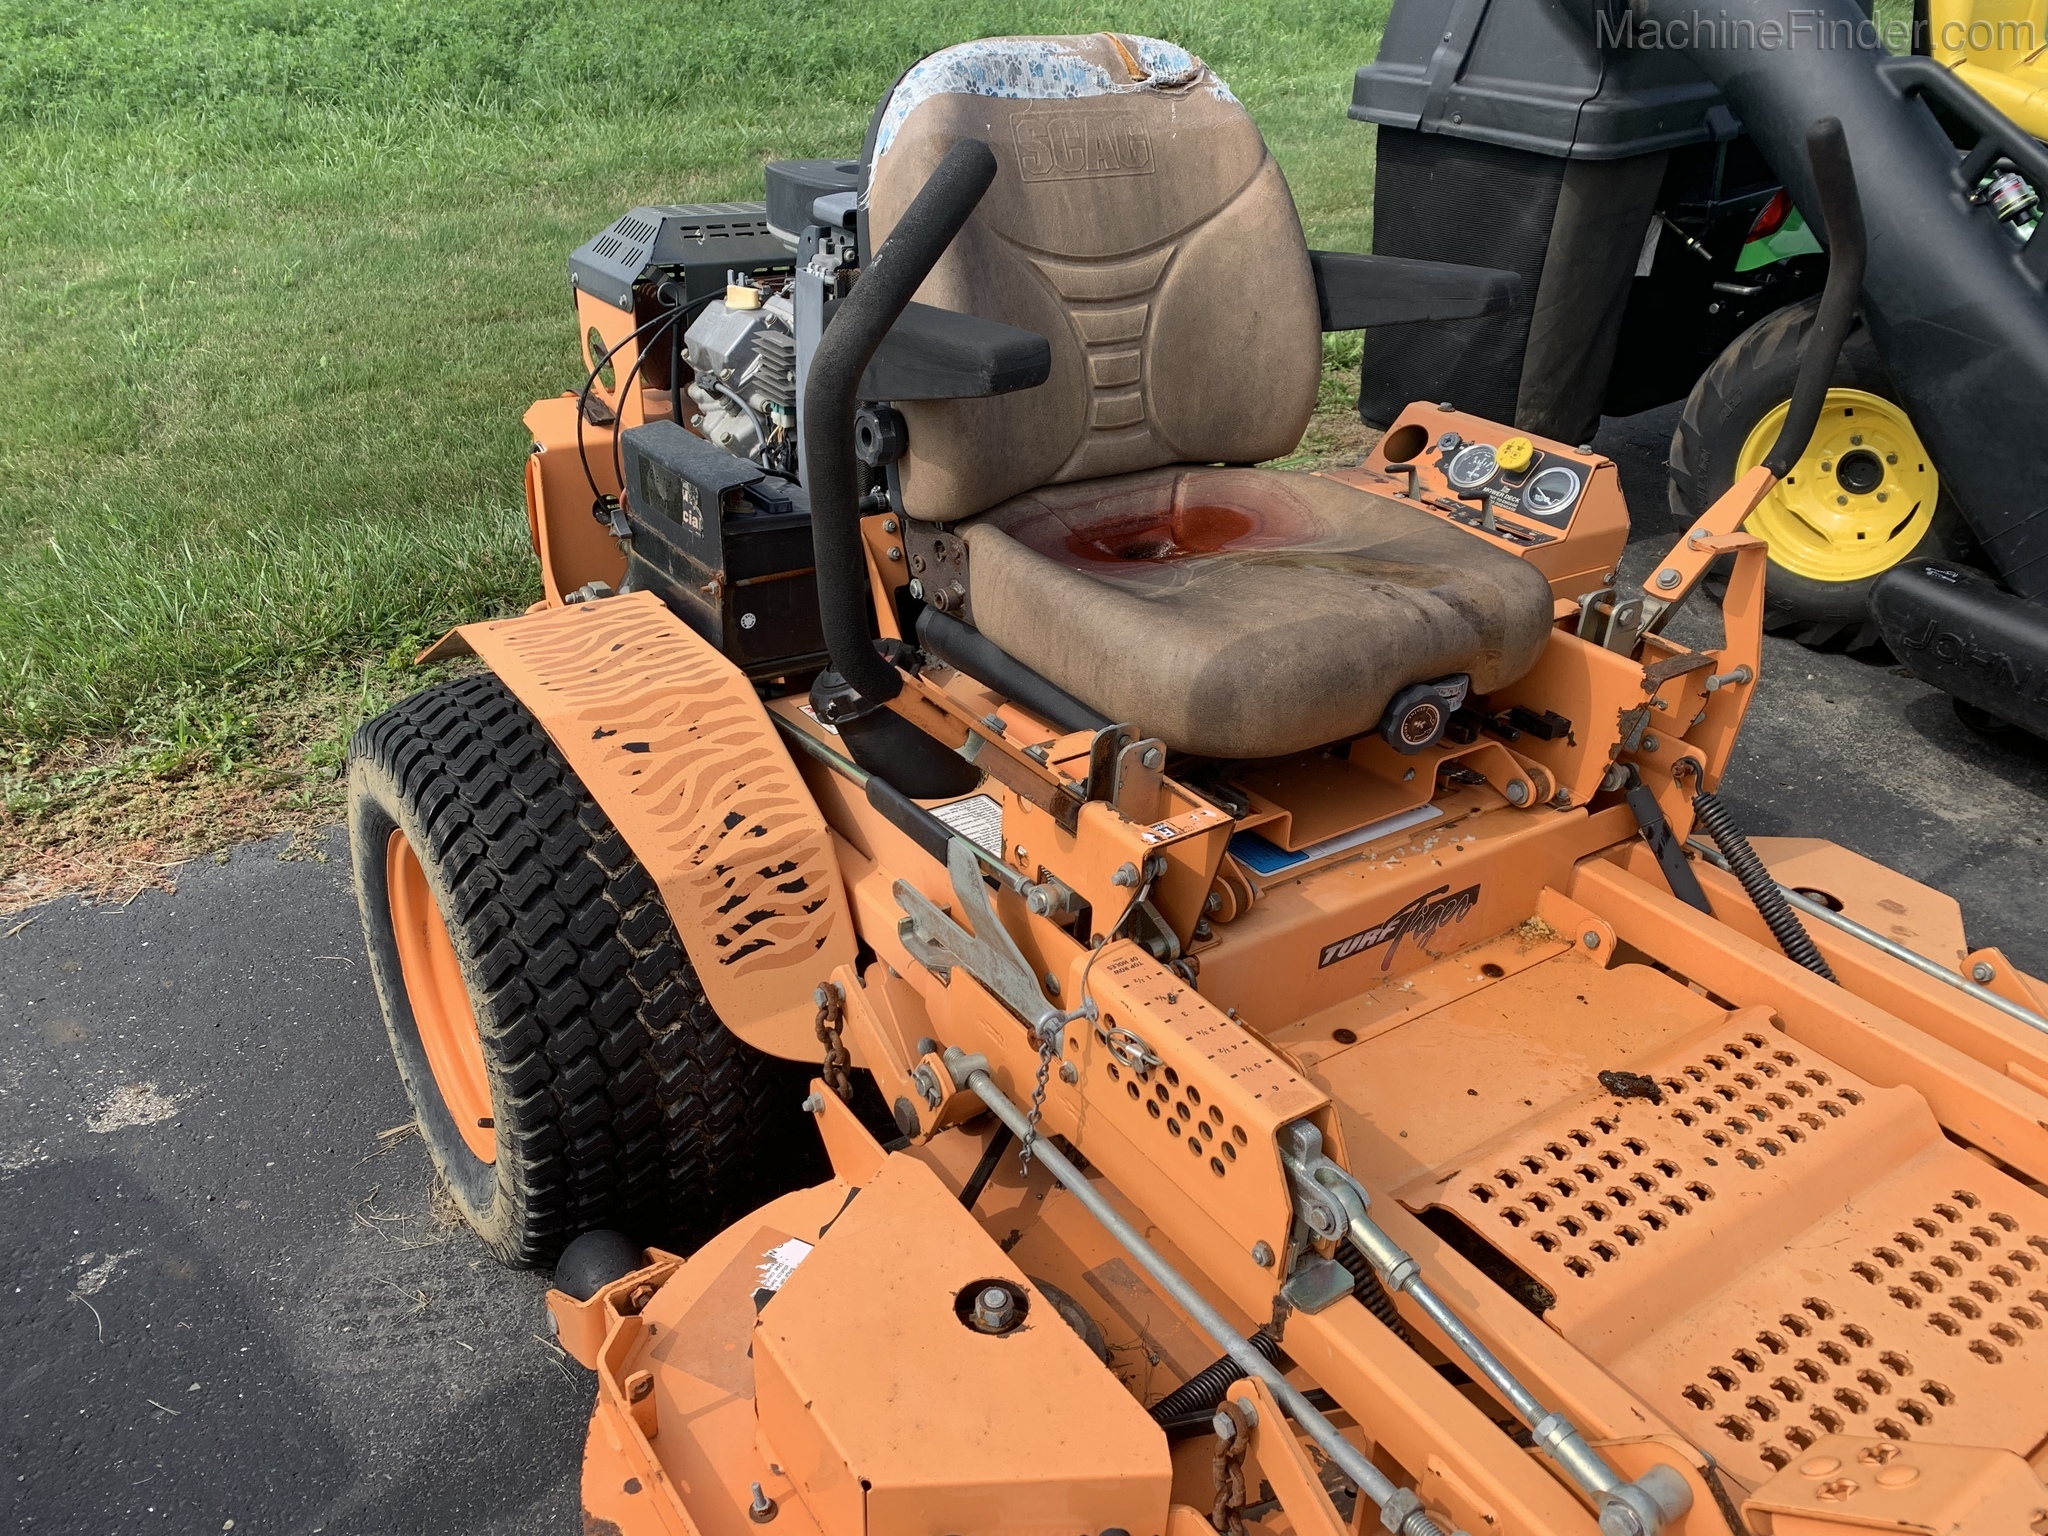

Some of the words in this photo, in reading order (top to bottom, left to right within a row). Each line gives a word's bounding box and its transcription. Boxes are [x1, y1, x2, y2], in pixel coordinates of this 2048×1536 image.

[1015, 113, 1150, 176] SCAG
[1482, 486, 1505, 498] MOWER
[1503, 493, 1521, 503] DECK
[1903, 619, 2034, 696] JOHN
[1321, 918, 1400, 966] TURF
[1380, 884, 1472, 972] Tiger
[1106, 960, 1130, 971] HOLES
[1113, 966, 1130, 975] ROW
[1130, 961, 1144, 969] TOP
[1271, 1084, 1280, 1092] 6
